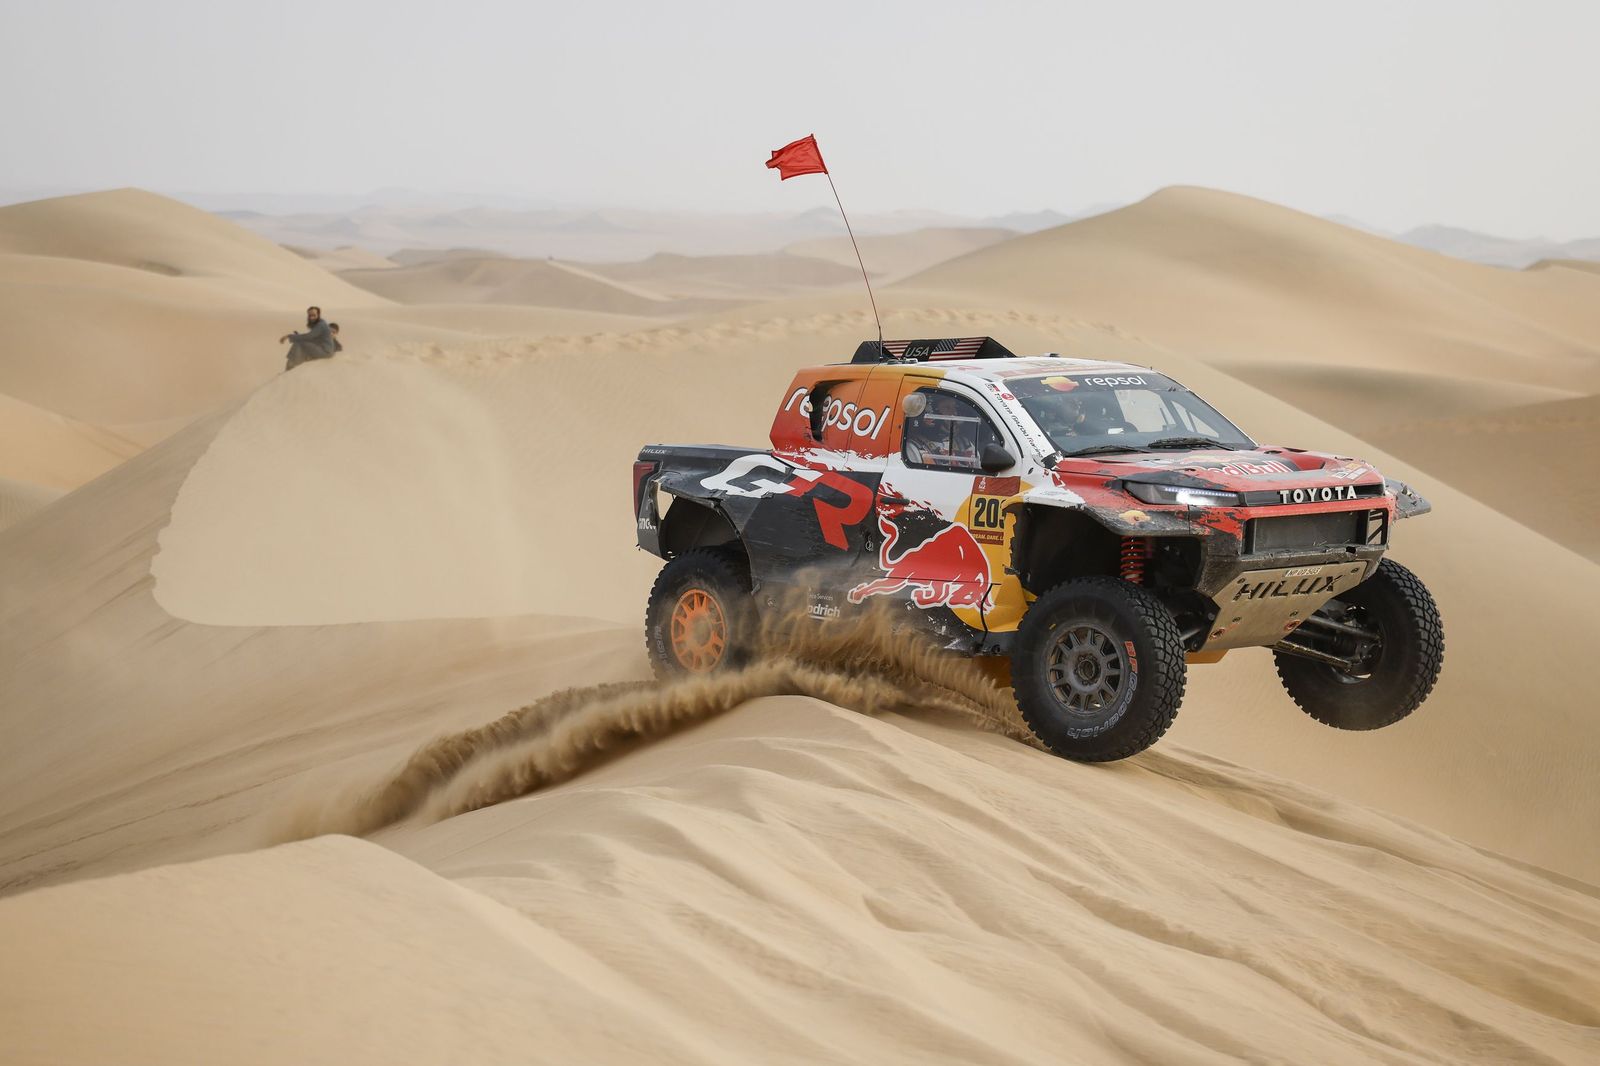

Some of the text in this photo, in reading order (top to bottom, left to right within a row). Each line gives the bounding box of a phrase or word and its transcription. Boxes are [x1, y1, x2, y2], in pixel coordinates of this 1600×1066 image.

[905, 346, 931, 358] USA
[1084, 375, 1147, 388] repsol
[784, 387, 890, 440] repsol
[700, 454, 874, 551] GR
[1279, 485, 1358, 505] TOYOTA
[1232, 575, 1343, 602] HILUX
